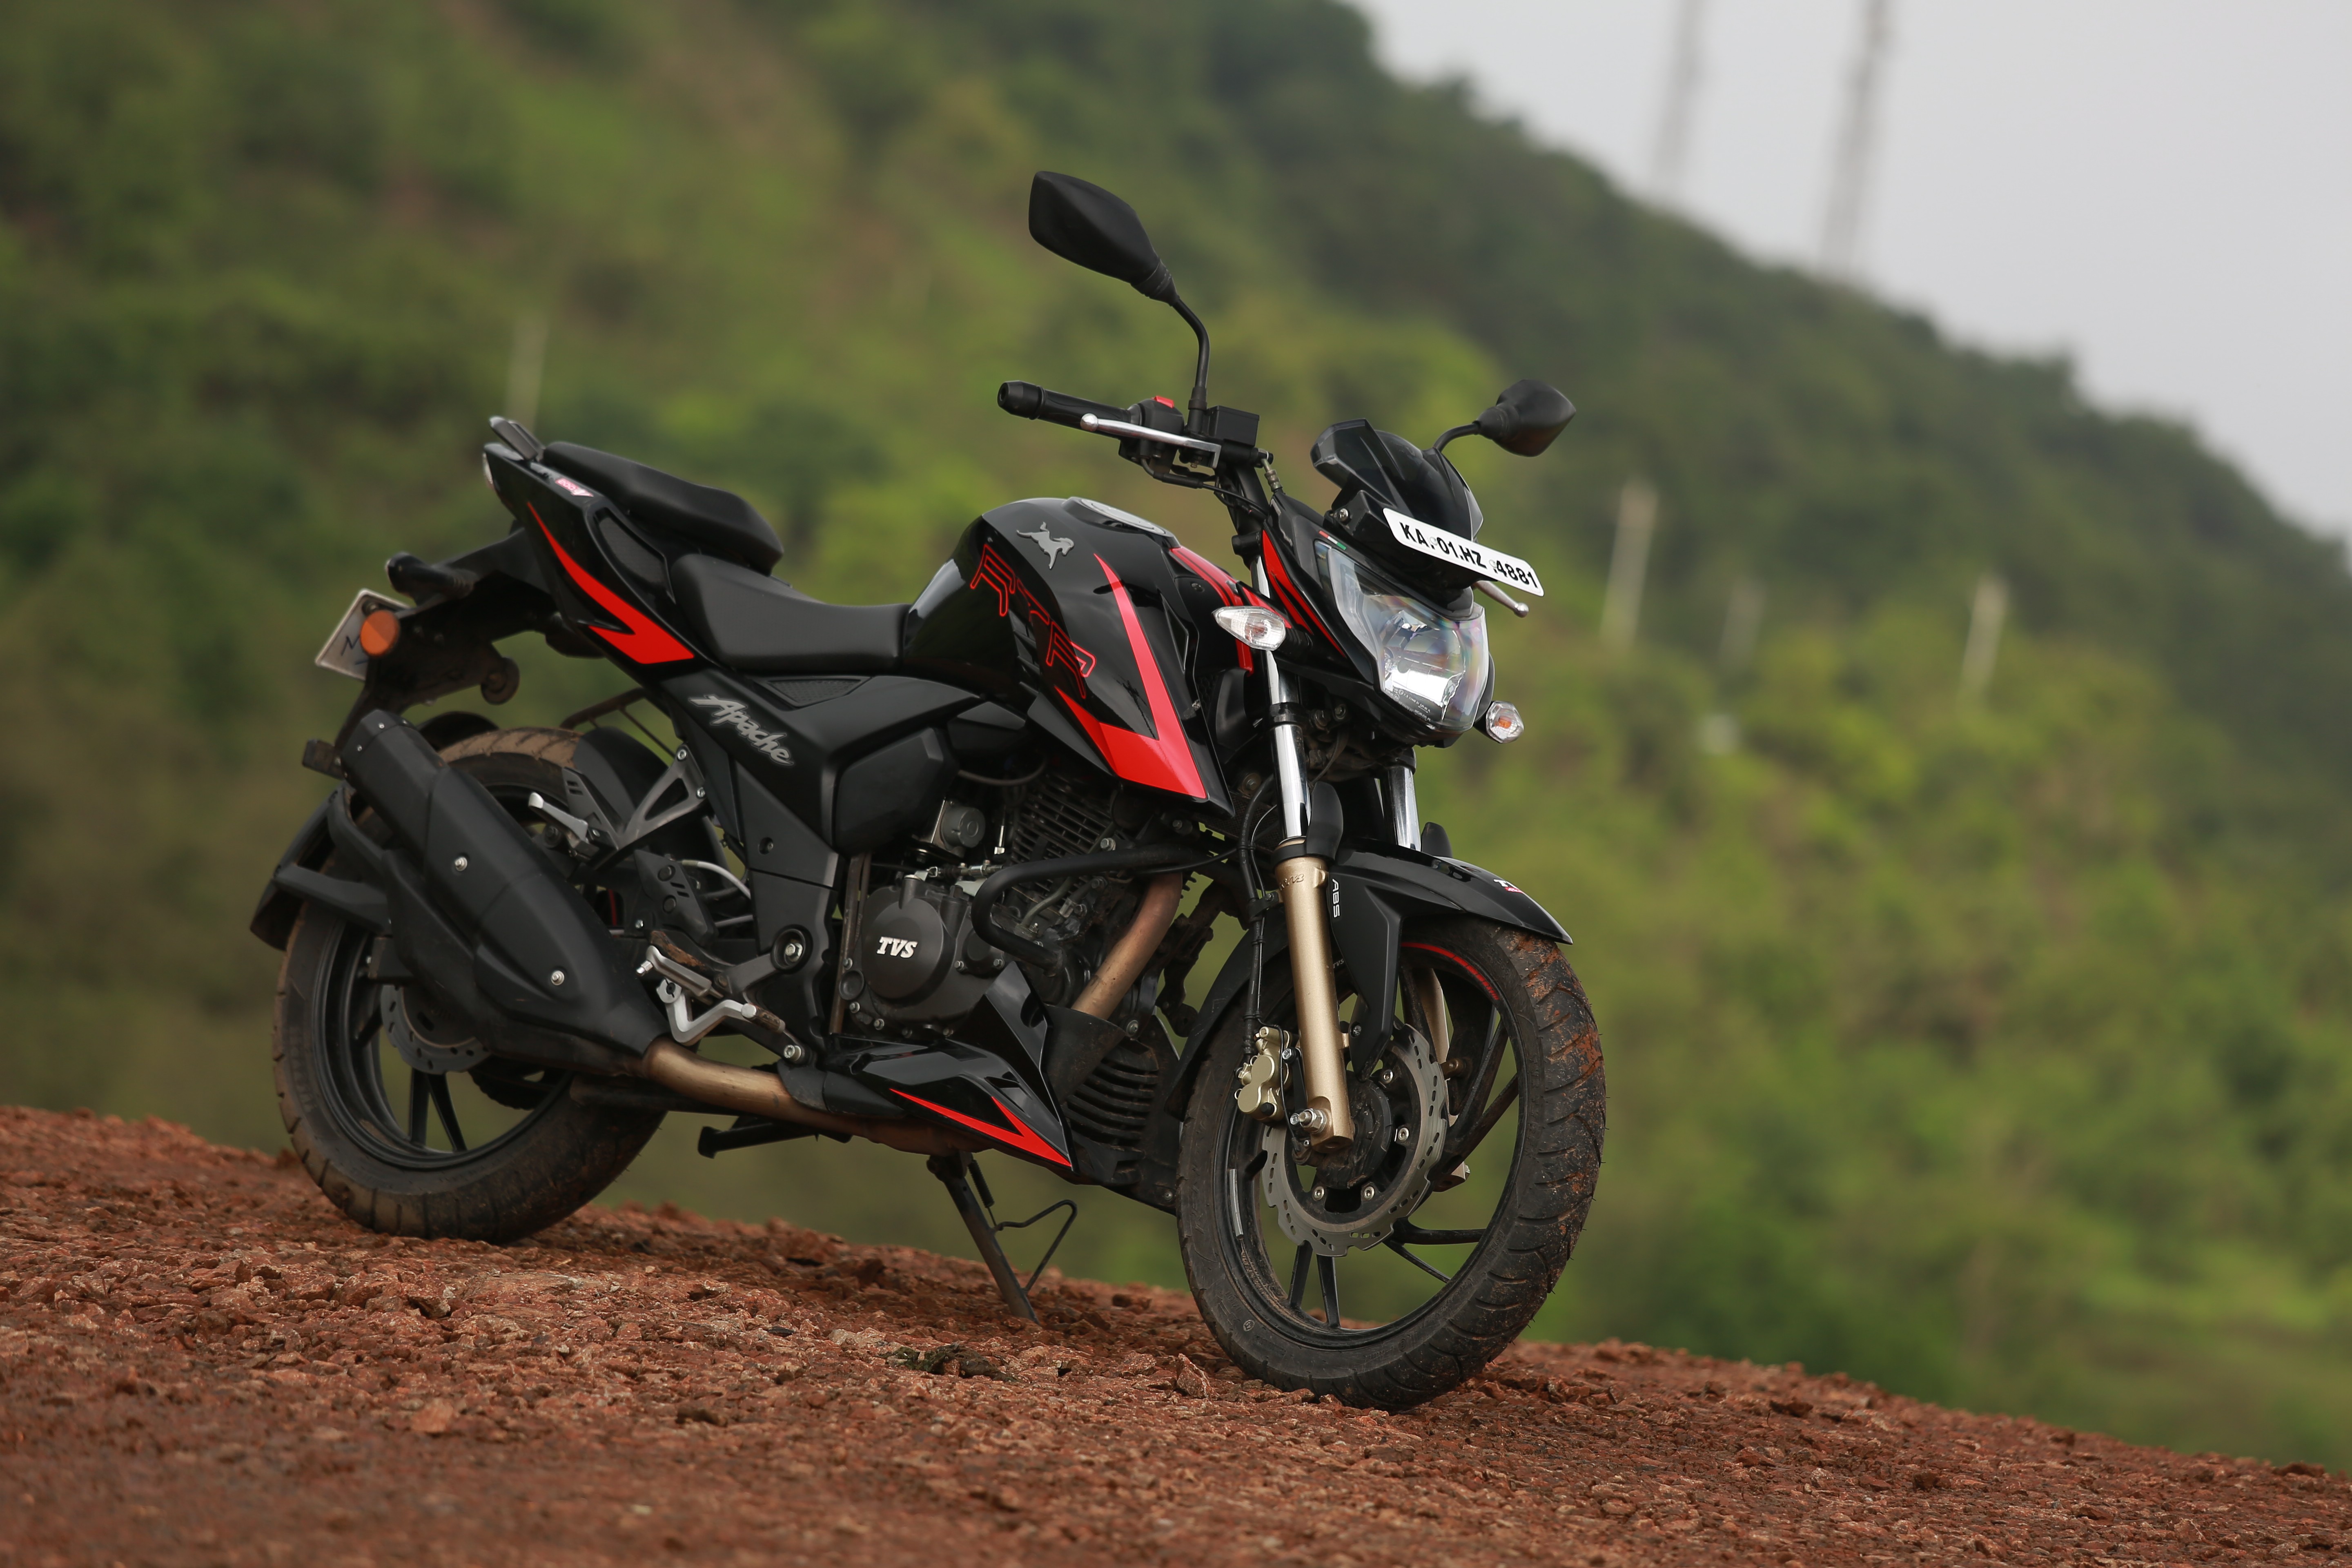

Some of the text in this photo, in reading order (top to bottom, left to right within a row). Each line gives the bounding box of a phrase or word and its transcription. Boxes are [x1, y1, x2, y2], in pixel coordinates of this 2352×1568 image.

[688, 695, 794, 766] Apache
[1332, 878, 1340, 918] ABS
[876, 936, 918, 958] TVS
